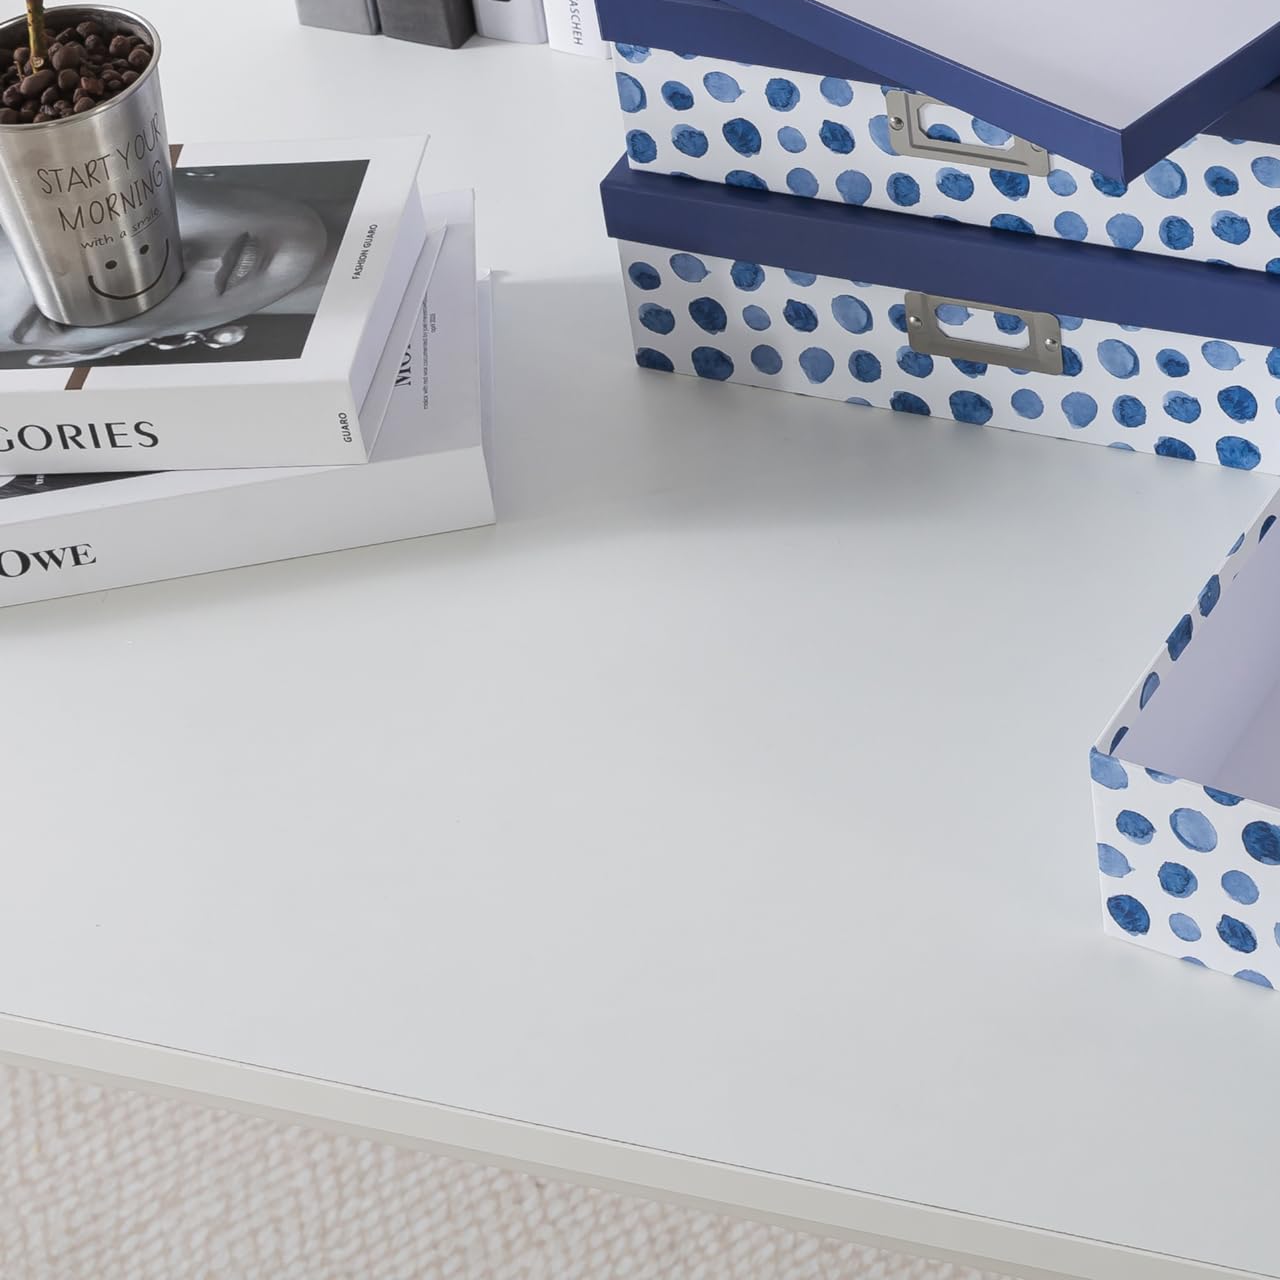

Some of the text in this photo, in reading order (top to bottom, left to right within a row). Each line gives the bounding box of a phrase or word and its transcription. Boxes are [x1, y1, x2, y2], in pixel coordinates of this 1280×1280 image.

[37, 112, 161, 194] START YOUR
[58, 160, 163, 231] MORNING
[81, 235, 114, 249] with
[119, 230, 127, 238] a
[352, 247, 369, 279] FASHION
[0, 543, 96, 578] OWE
